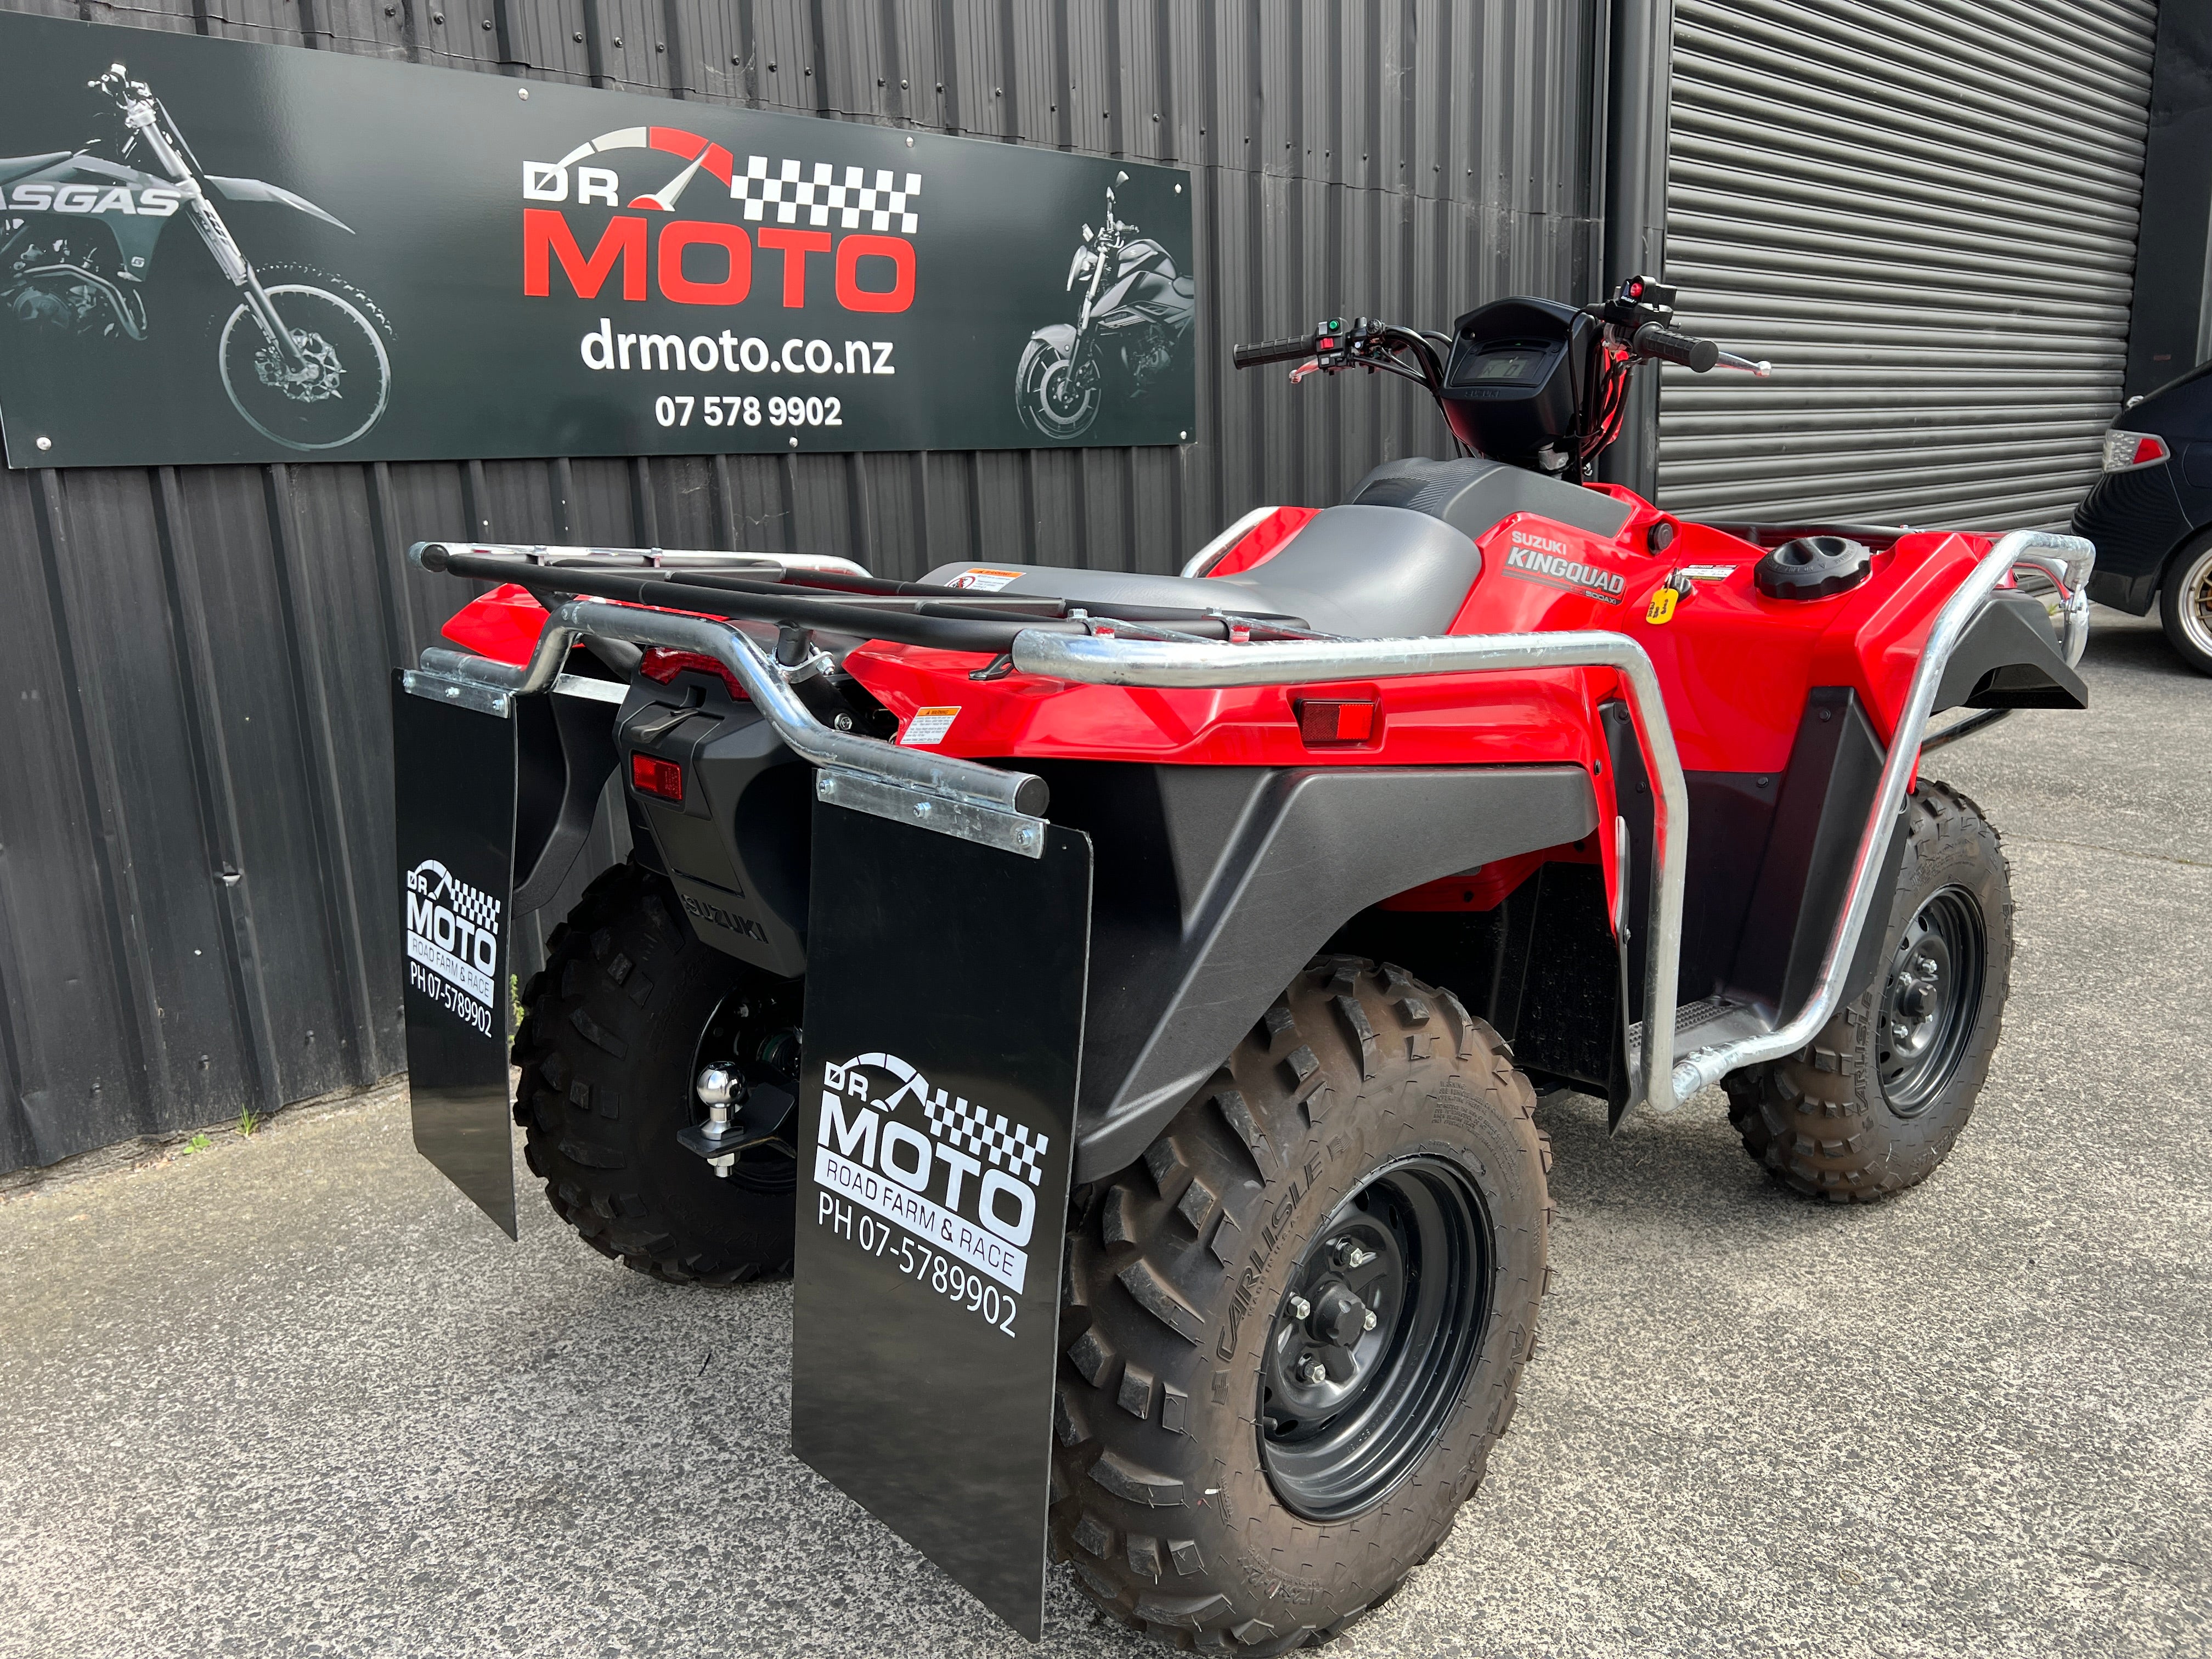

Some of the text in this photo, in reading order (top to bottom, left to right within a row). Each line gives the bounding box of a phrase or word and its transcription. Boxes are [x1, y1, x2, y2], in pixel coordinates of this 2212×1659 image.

[0, 184, 181, 217] SGAS
[523, 160, 619, 207] DR
[523, 208, 916, 313] MOTO
[580, 317, 896, 375] drmoto.co.nz
[655, 396, 843, 426] 07 578 9902
[1508, 546, 1625, 594] KINGQUAD
[1511, 531, 1566, 555] SUZUKI
[407, 870, 428, 896] DR
[407, 890, 497, 977] MOTO
[681, 894, 769, 944] SUZUKI
[413, 938, 489, 998] ROAD FARM & RACE
[410, 961, 492, 1039] PH 07-5789902
[824, 1061, 869, 1102] DR
[817, 1090, 1036, 1248] MOTO
[827, 1159, 1015, 1277] ROAD FARM & RACE
[819, 1191, 1017, 1339] PH 07-5789902
[1216, 1152, 1323, 1363] CARLISLE
